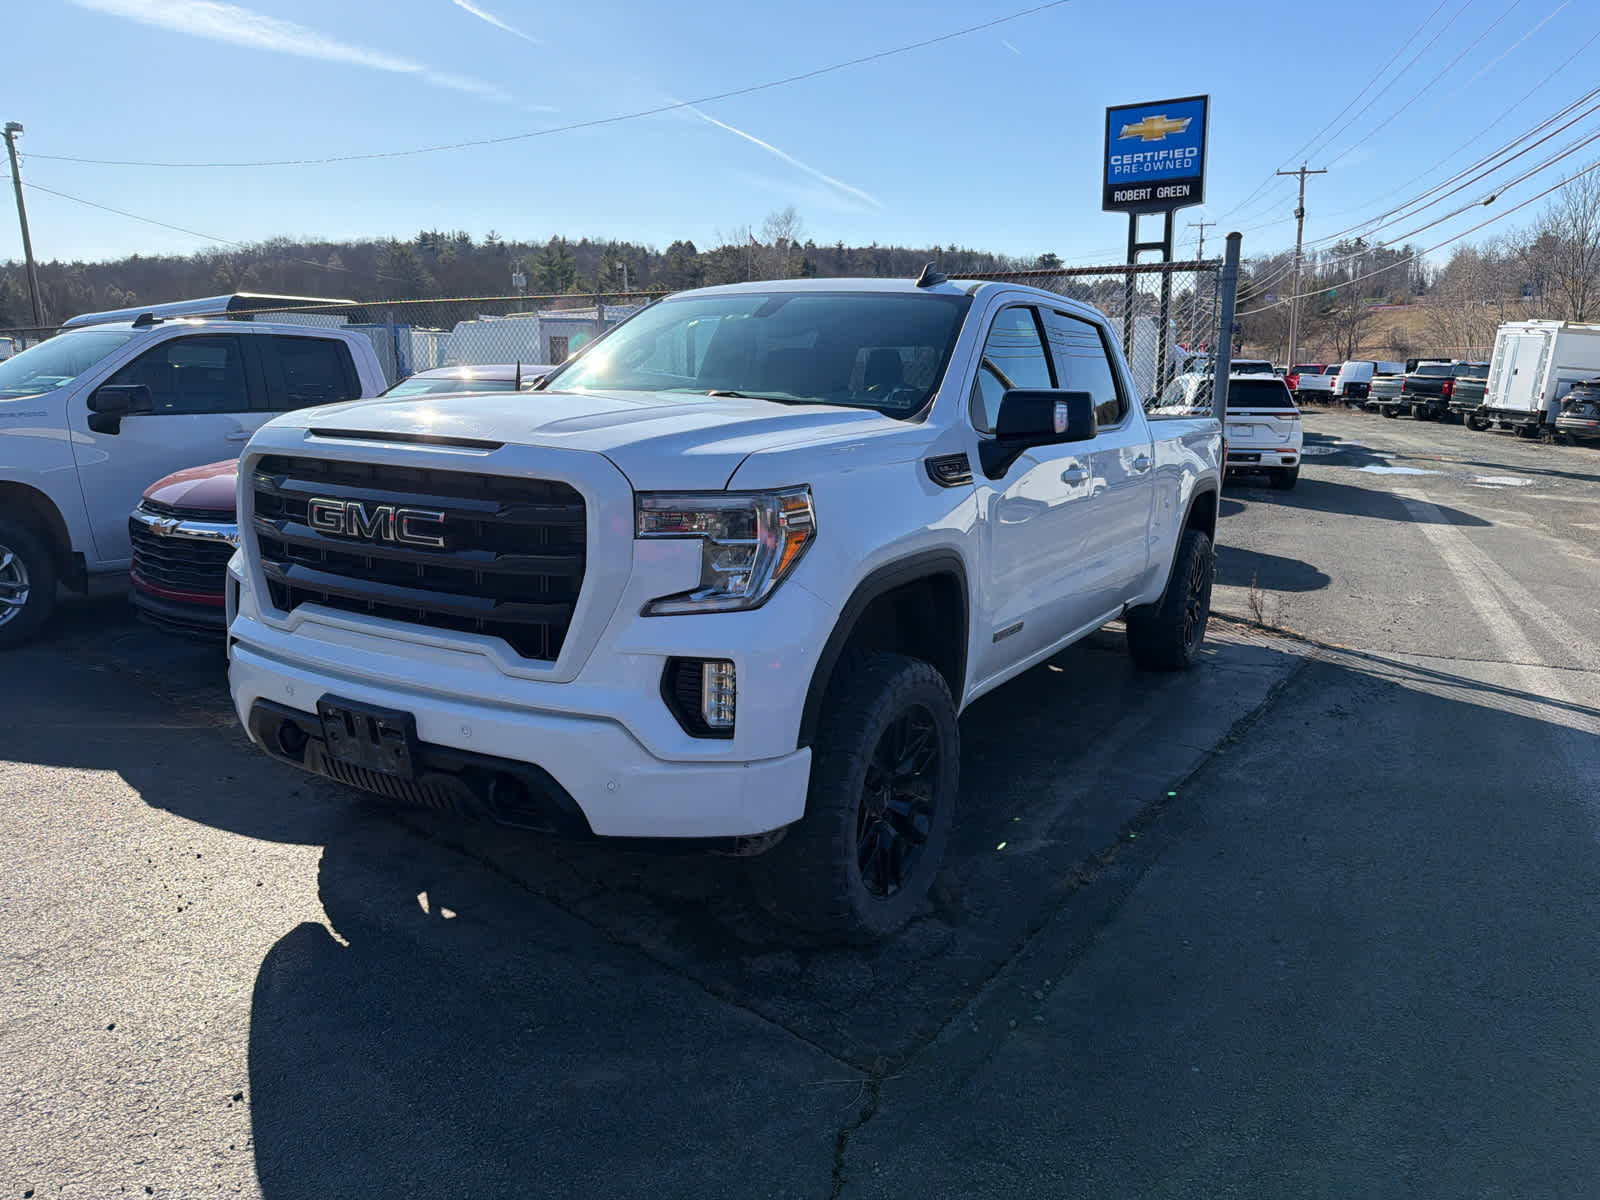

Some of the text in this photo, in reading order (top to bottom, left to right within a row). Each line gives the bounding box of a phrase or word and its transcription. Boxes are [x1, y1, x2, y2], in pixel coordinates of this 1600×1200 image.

[1111, 147, 1198, 165] CERTIFIED
[1114, 159, 1192, 175] PRE-OWNED
[1114, 185, 1190, 202] ROBERT GREEN
[308, 498, 446, 547] GMC
